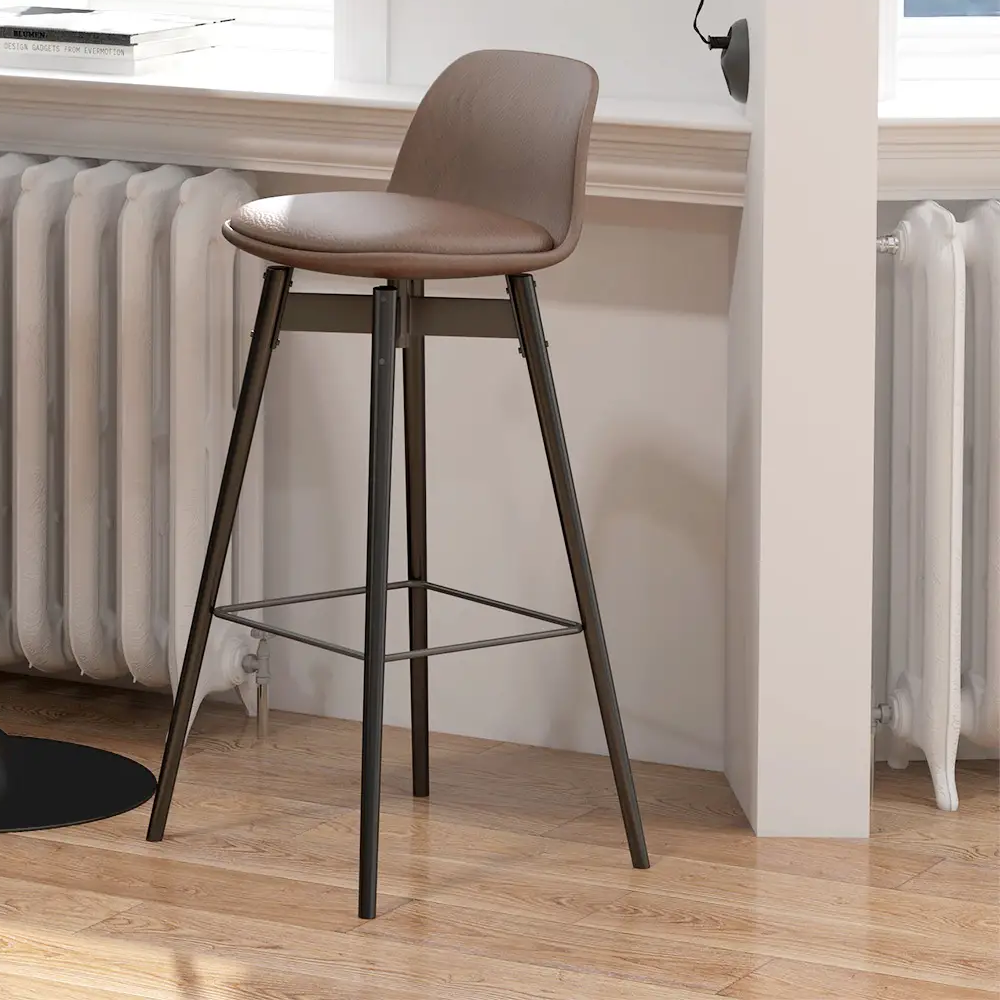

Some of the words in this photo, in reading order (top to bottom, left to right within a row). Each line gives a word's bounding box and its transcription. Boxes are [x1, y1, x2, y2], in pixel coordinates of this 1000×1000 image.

[4, 42, 28, 51] DESIGN
[31, 44, 60, 52] GADGETS
[84, 47, 125, 56] EVERMOTION
